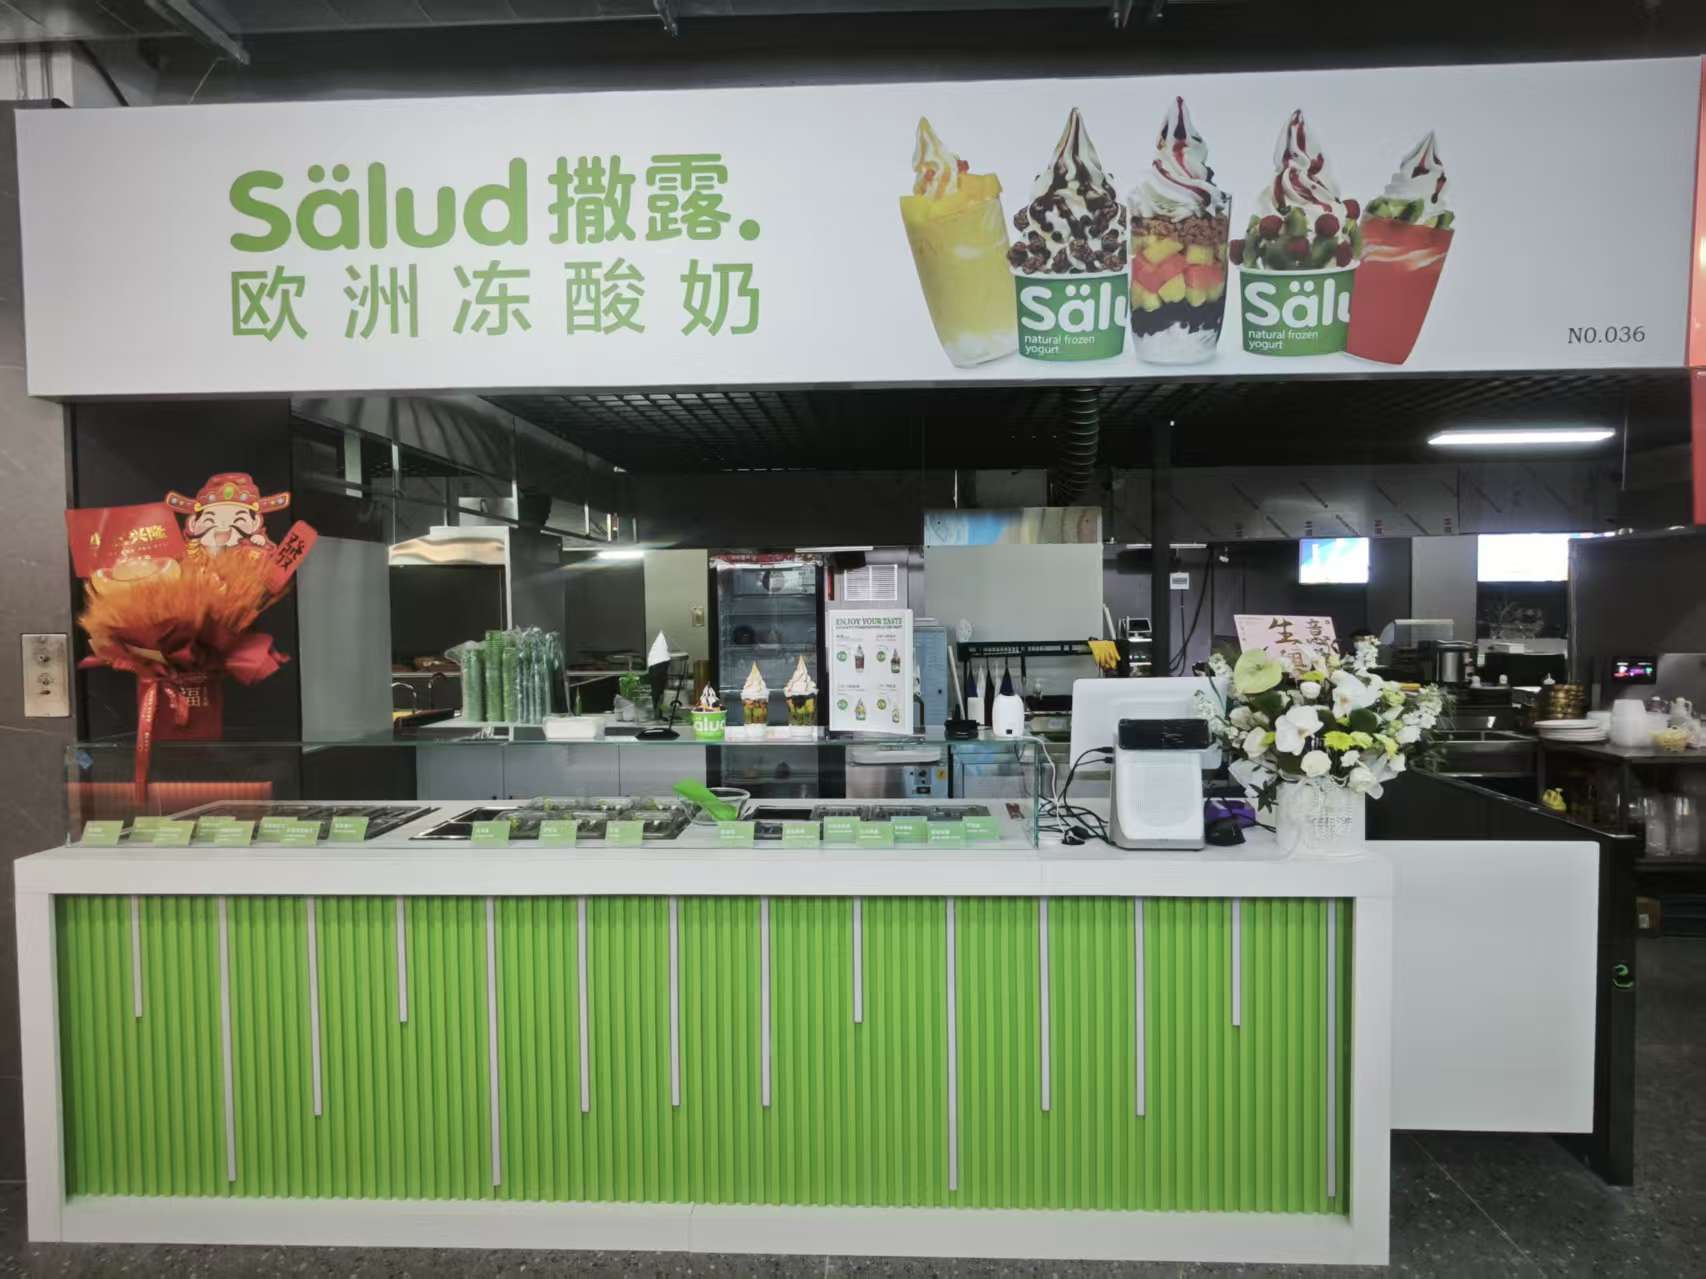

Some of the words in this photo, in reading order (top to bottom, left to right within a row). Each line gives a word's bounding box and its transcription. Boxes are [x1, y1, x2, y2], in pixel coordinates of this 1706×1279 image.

[230, 159, 528, 253] Sälud
[231, 258, 760, 341] 欧洲冻酸奶
[1248, 330, 1285, 339] natural
[1288, 329, 1318, 339] frozen
[1567, 325, 1646, 344] NO.036
[1024, 335, 1062, 345] natural
[1064, 334, 1095, 344] frozen
[1024, 345, 1059, 355] yogurt
[1248, 340, 1283, 350] yogurt
[836, 616, 860, 625] ENJOY
[863, 616, 881, 625] YOUR
[883, 616, 903, 625] TASTE
